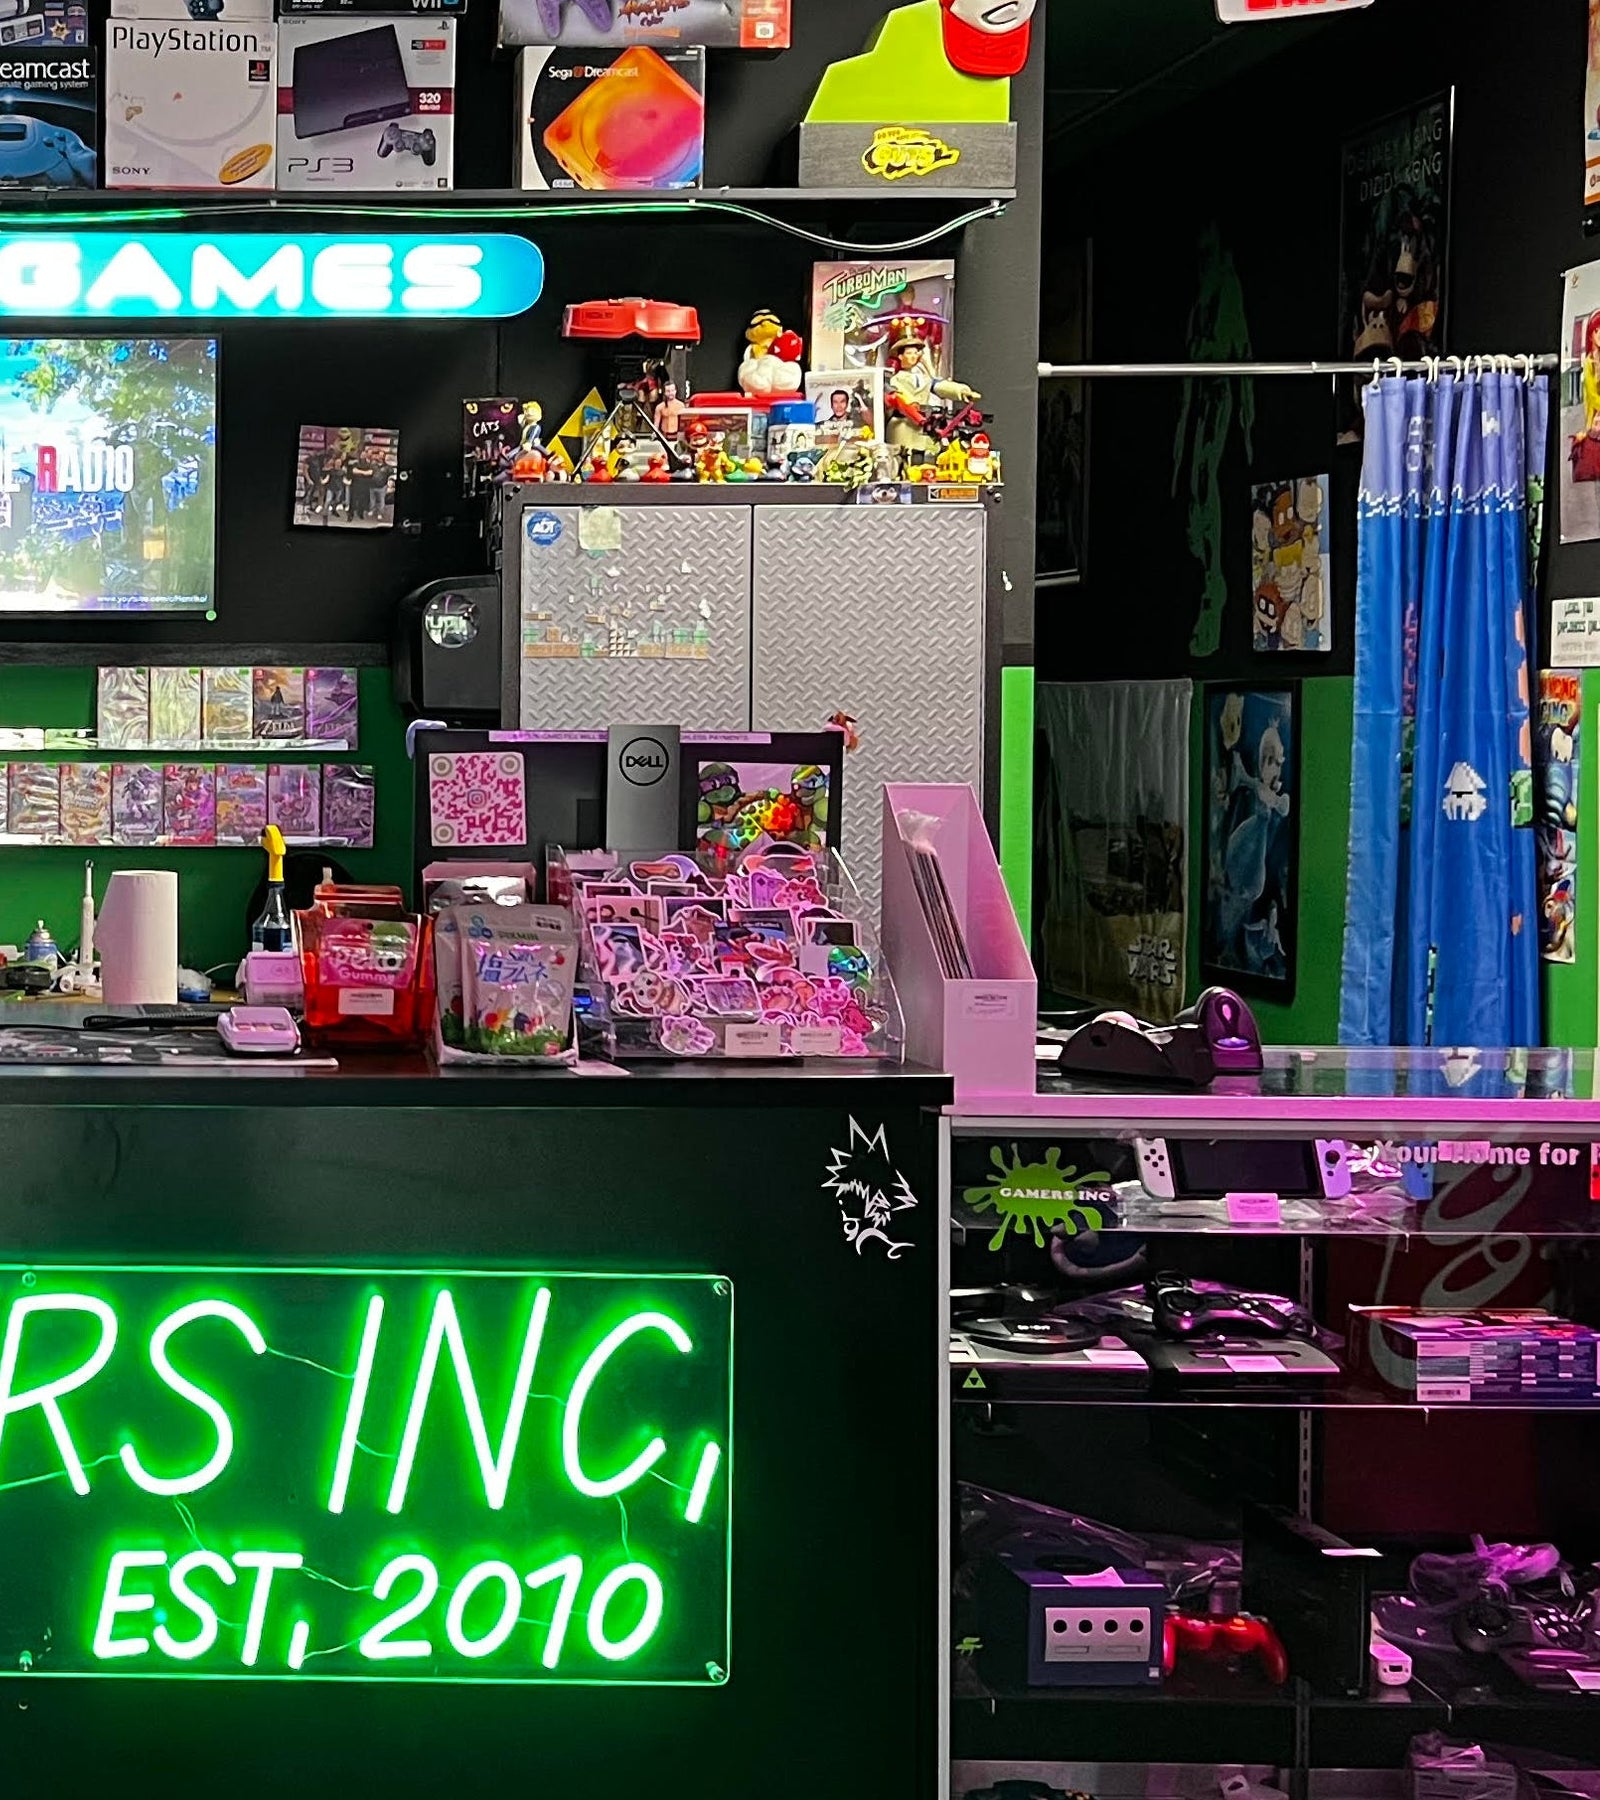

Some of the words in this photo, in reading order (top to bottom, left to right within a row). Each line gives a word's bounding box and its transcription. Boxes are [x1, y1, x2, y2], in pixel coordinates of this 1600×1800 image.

[113, 27, 258, 57] PlayStation
[548, 66, 573, 80] Sega
[584, 65, 640, 78] Dreamcast
[24, 81, 58, 90] gaming
[60, 81, 89, 90] system
[419, 93, 442, 104] 320
[113, 167, 151, 176] SONY
[288, 158, 354, 173] PS3
[20, 241, 484, 313] GAMES
[473, 420, 500, 437] CATS
[37, 444, 135, 493] RADIO
[626, 756, 664, 768] DELL
[1374, 1140, 1438, 1165] Your
[1539, 1142, 1580, 1165] for
[1000, 1187, 1074, 1201] GAMERS
[1078, 1189, 1111, 1203] INC
[358, 1552, 666, 1667] 2010
